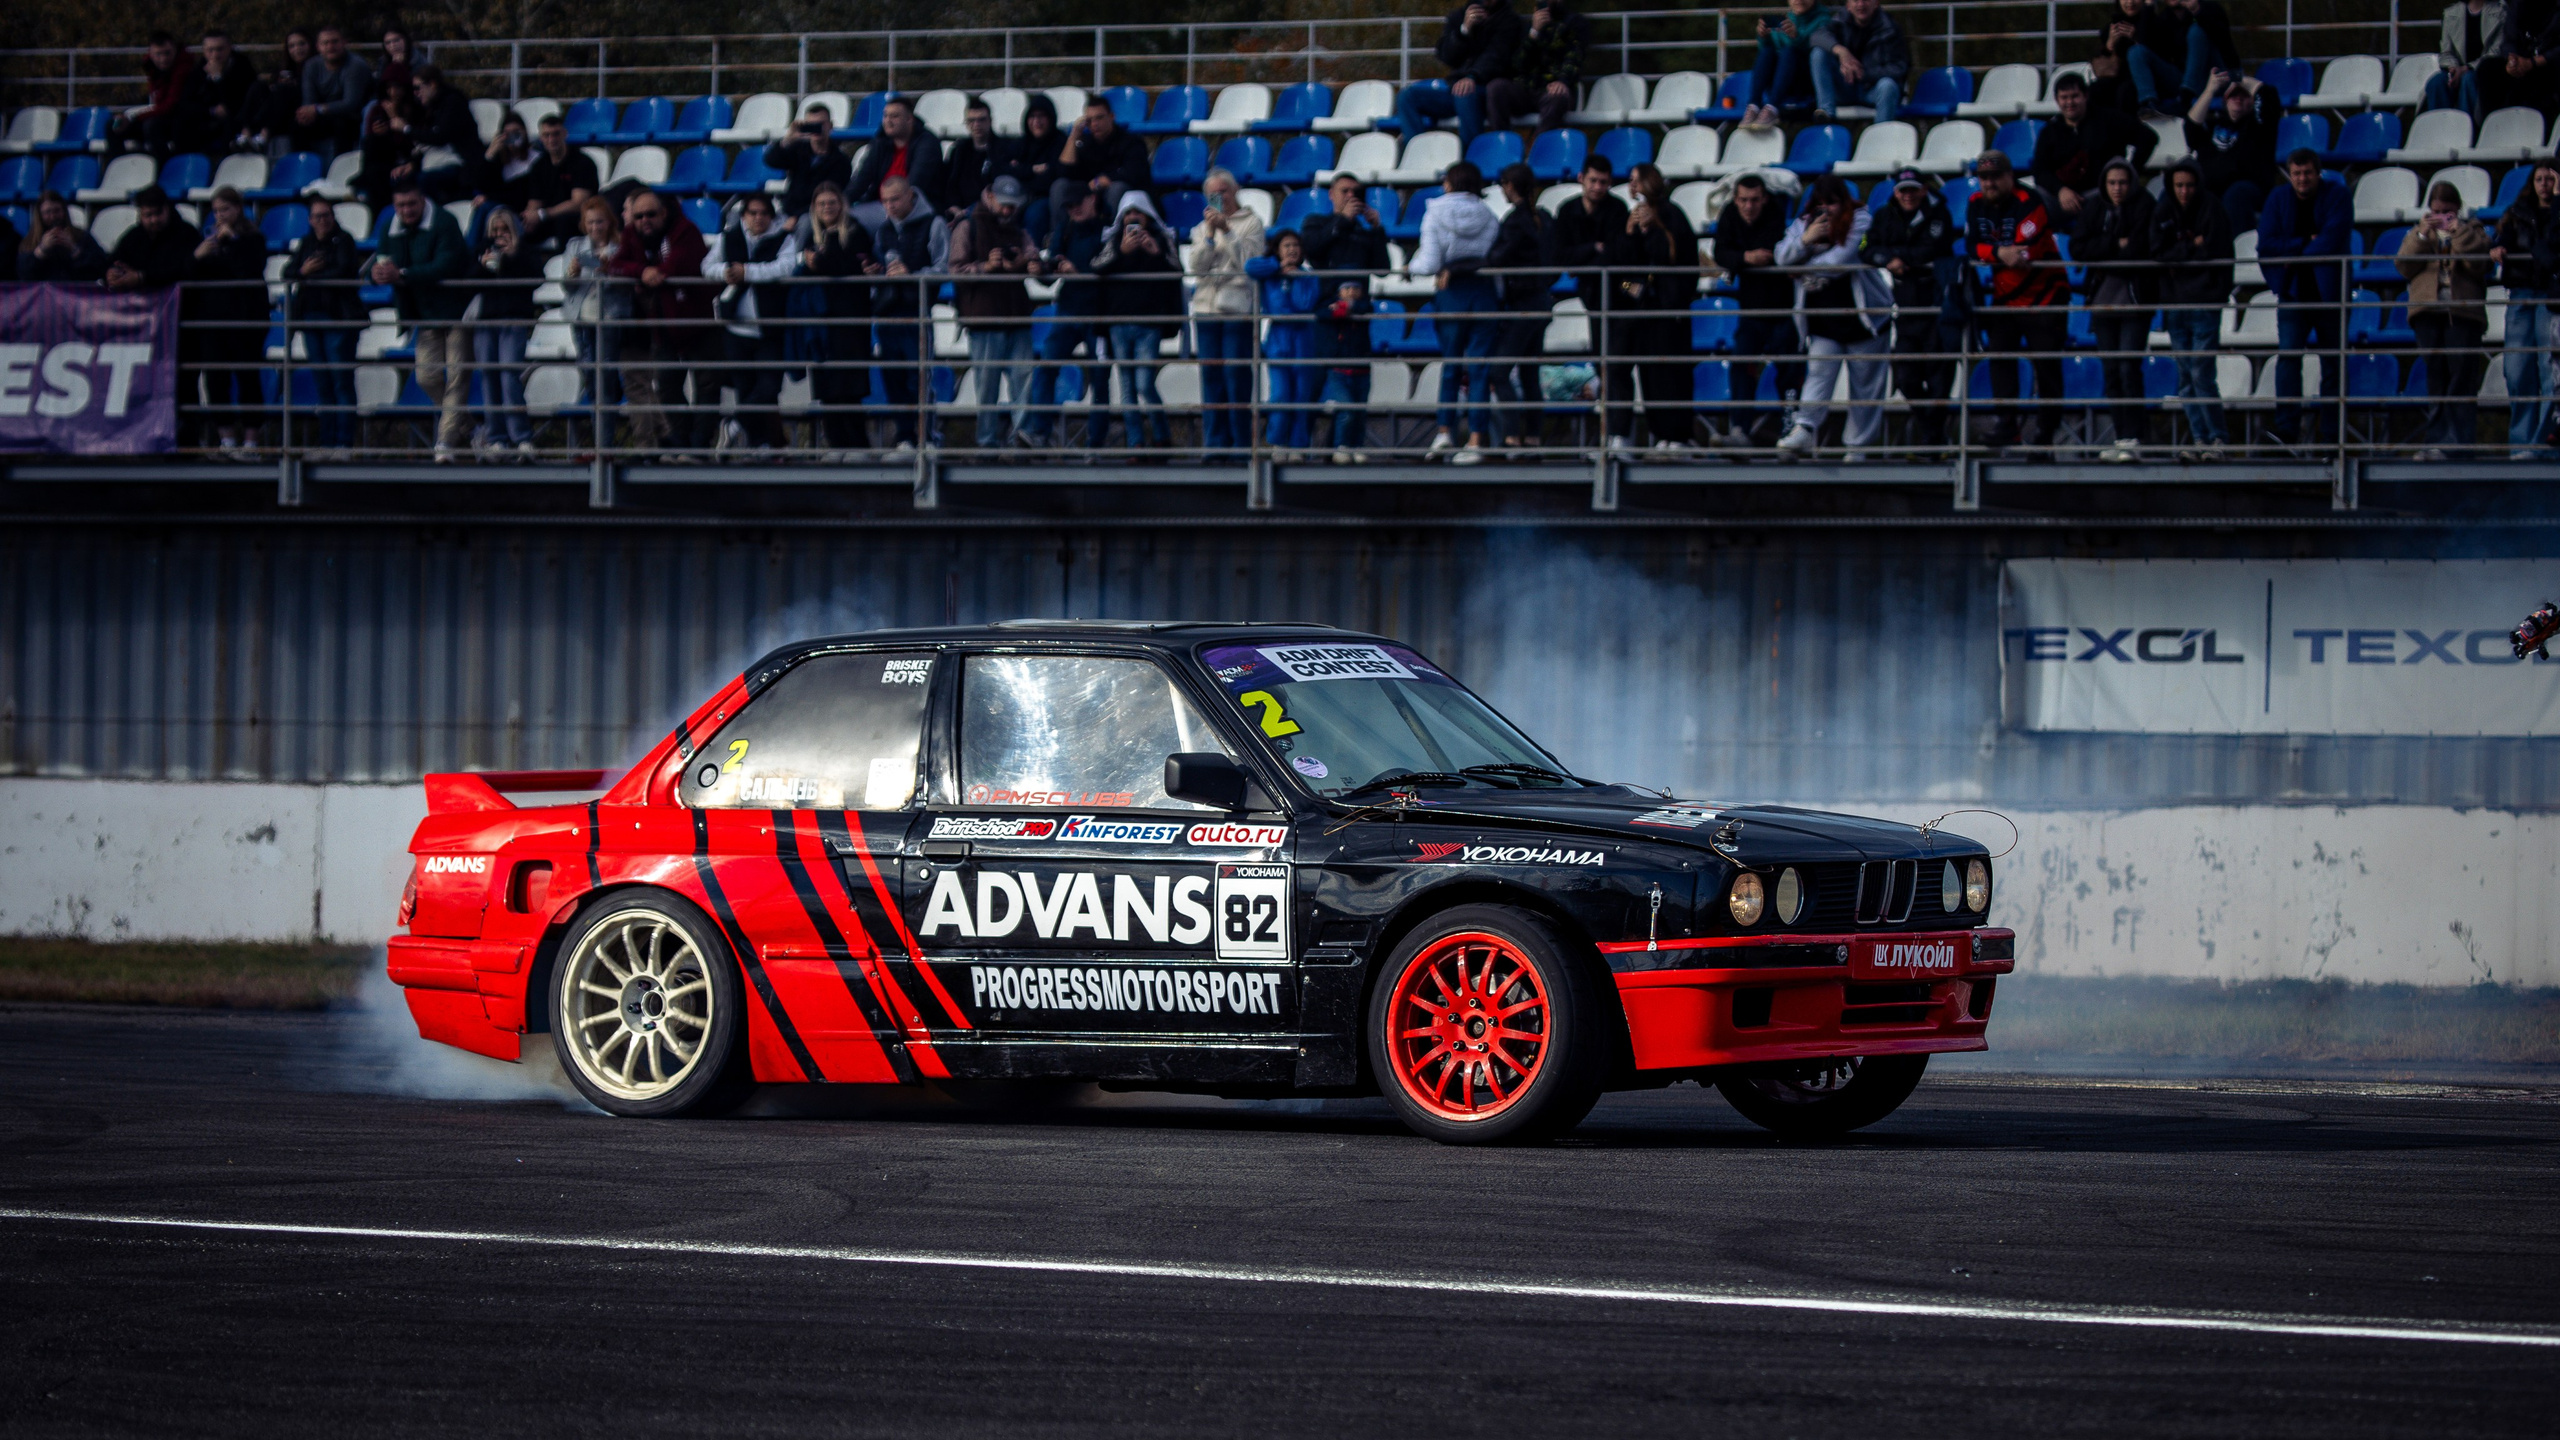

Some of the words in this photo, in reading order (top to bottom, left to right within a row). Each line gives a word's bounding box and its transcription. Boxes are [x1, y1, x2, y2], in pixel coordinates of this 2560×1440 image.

[1275, 649, 1328, 662] ADM
[1325, 648, 1381, 661] DRIFT
[885, 660, 932, 670] BRISKET
[1290, 661, 1402, 677] CONTEST
[881, 671, 927, 685] BOYS
[1240, 690, 1302, 738] 2
[722, 739, 749, 774] 2
[990, 790, 1135, 806] PMSCLUBS
[1191, 825, 1284, 843] auto.ru
[425, 857, 485, 873] ADVANS
[1460, 846, 1604, 866] YOKOHAMA
[1237, 867, 1286, 877] YOKOHAMA
[919, 870, 1212, 944] ADVANS
[1225, 894, 1279, 942] 82
[1890, 941, 1954, 968] ЛУКОЙЛ
[970, 966, 1281, 1014] PROGRESSMOTORSPORT
